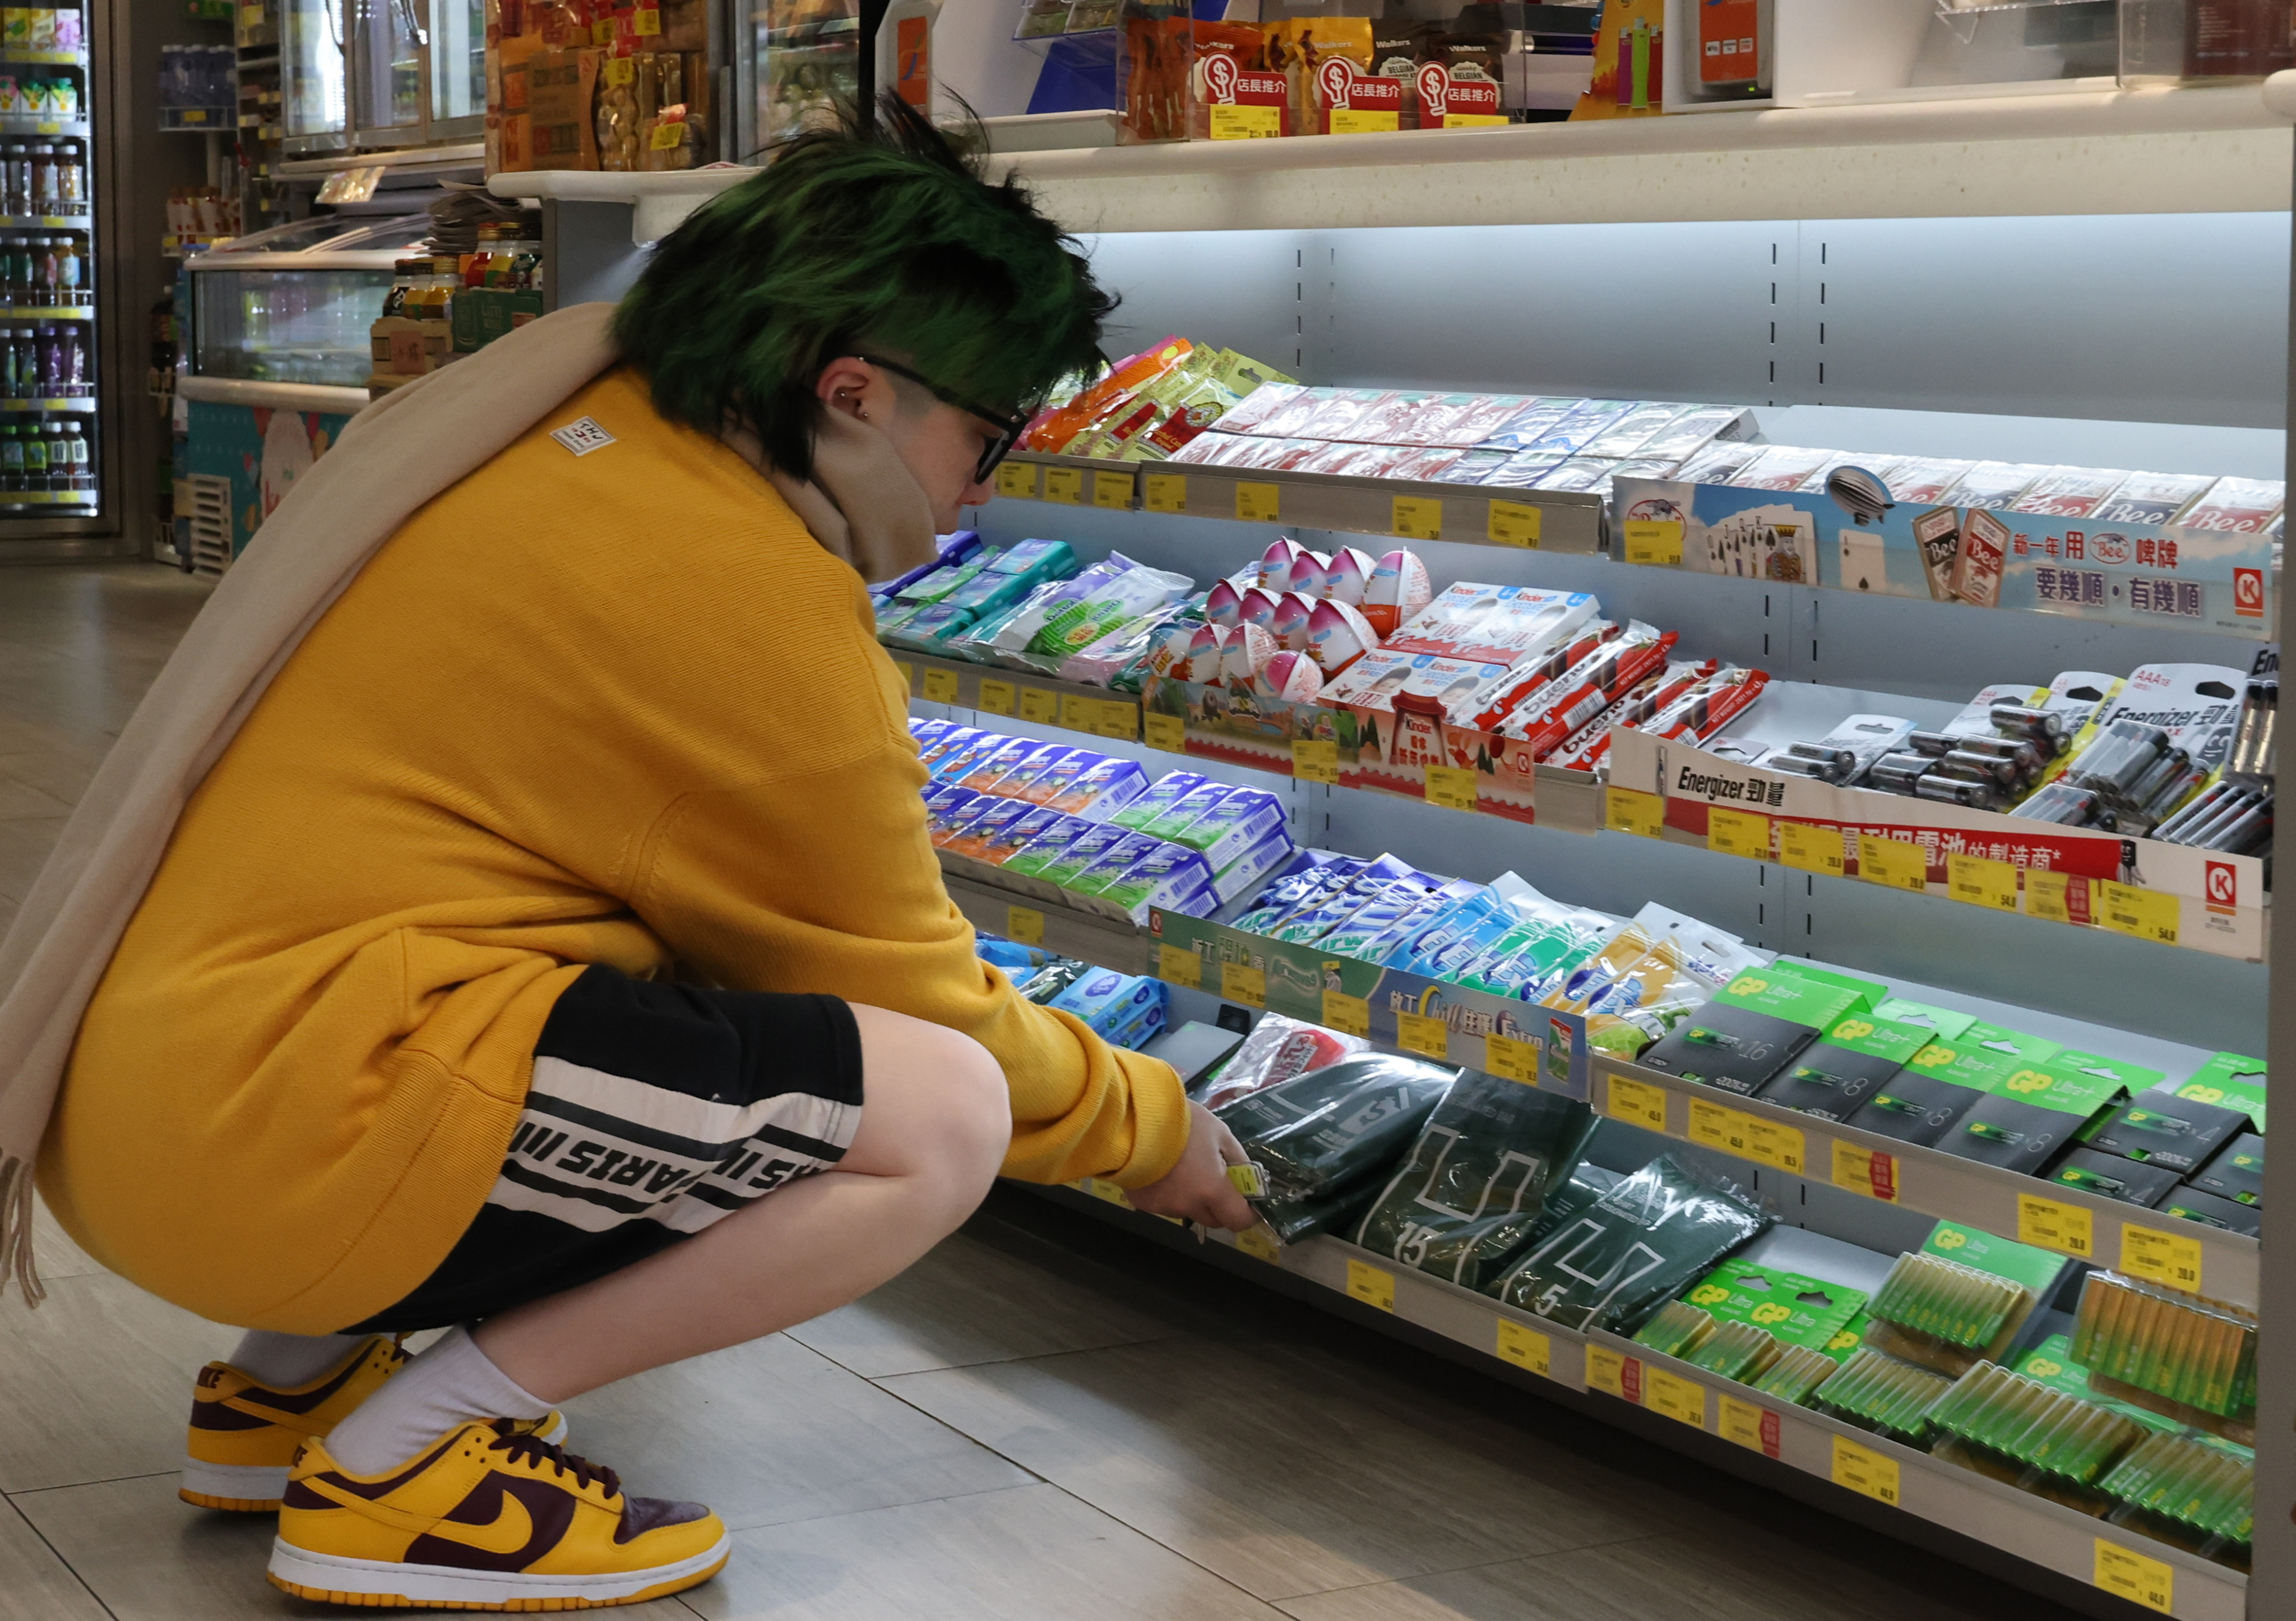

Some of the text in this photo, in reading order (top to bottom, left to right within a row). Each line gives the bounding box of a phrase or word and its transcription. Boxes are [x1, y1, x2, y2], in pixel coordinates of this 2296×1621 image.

[1376, 39, 1411, 49] Walkers
[1237, 78, 1287, 94] 店長推介
[1351, 83, 1400, 98] 店長推介
[1447, 87, 1496, 102] 店長推介
[2108, 504, 2165, 525] Bee
[2195, 510, 2256, 533] Bee
[2013, 532, 2084, 560] 新一年用
[2136, 538, 2179, 569] 啤牌
[1404, 713, 1432, 735] Kinder
[1562, 700, 1626, 754] bueno
[1677, 765, 1785, 807] Energizer 勁量
[1728, 976, 1769, 996] GP
[1832, 1019, 1874, 1041] GP
[1912, 1044, 1957, 1068] GP
[2006, 1069, 2054, 1094] GP
[2176, 1084, 2225, 1103] GP
[1934, 1228, 1967, 1250] GP
[1534, 1283, 1569, 1317] 5
[1690, 1283, 1730, 1306] GP
[1751, 1303, 1792, 1325] GP
[2026, 1357, 2062, 1378] GP
